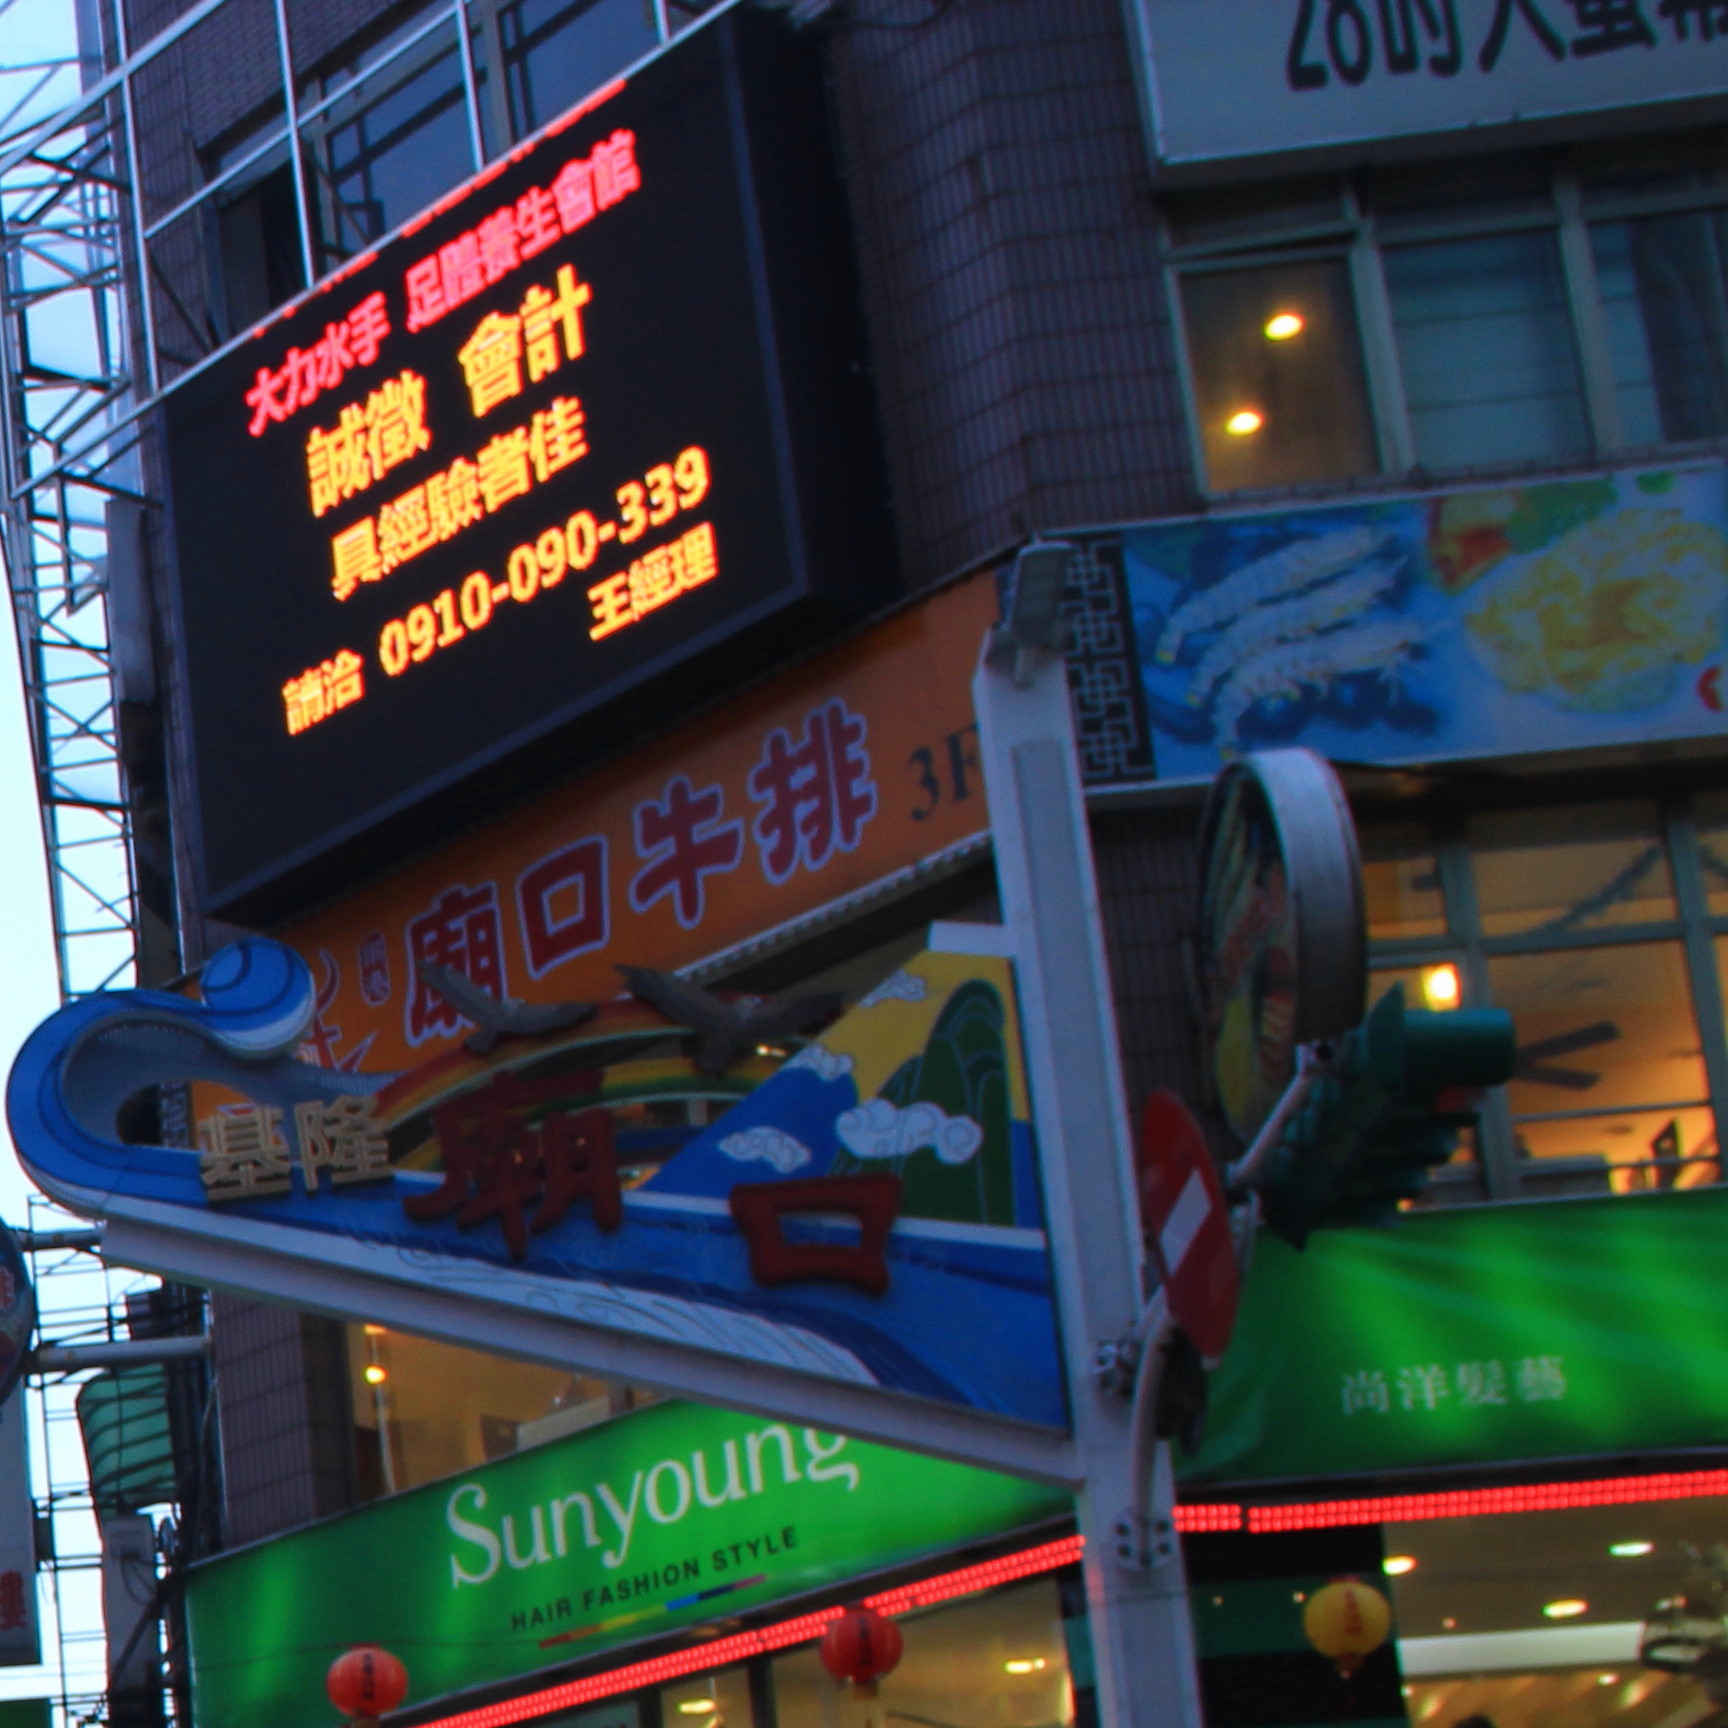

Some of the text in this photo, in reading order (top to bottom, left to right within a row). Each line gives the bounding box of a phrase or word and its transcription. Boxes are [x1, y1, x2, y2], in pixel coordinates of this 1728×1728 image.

[246, 291, 391, 437] 大力水手
[304, 262, 592, 518] 誠徵 會計
[282, 444, 712, 736] 請洽 0910-090-339
[330, 396, 589, 602] 具經驗者佳
[587, 521, 719, 642] 王經理
[404, 699, 879, 1049] 廟口牛排
[446, 1418, 862, 1590] Sunyoung
[510, 1525, 800, 1633] HAIR FASHION STYLE
